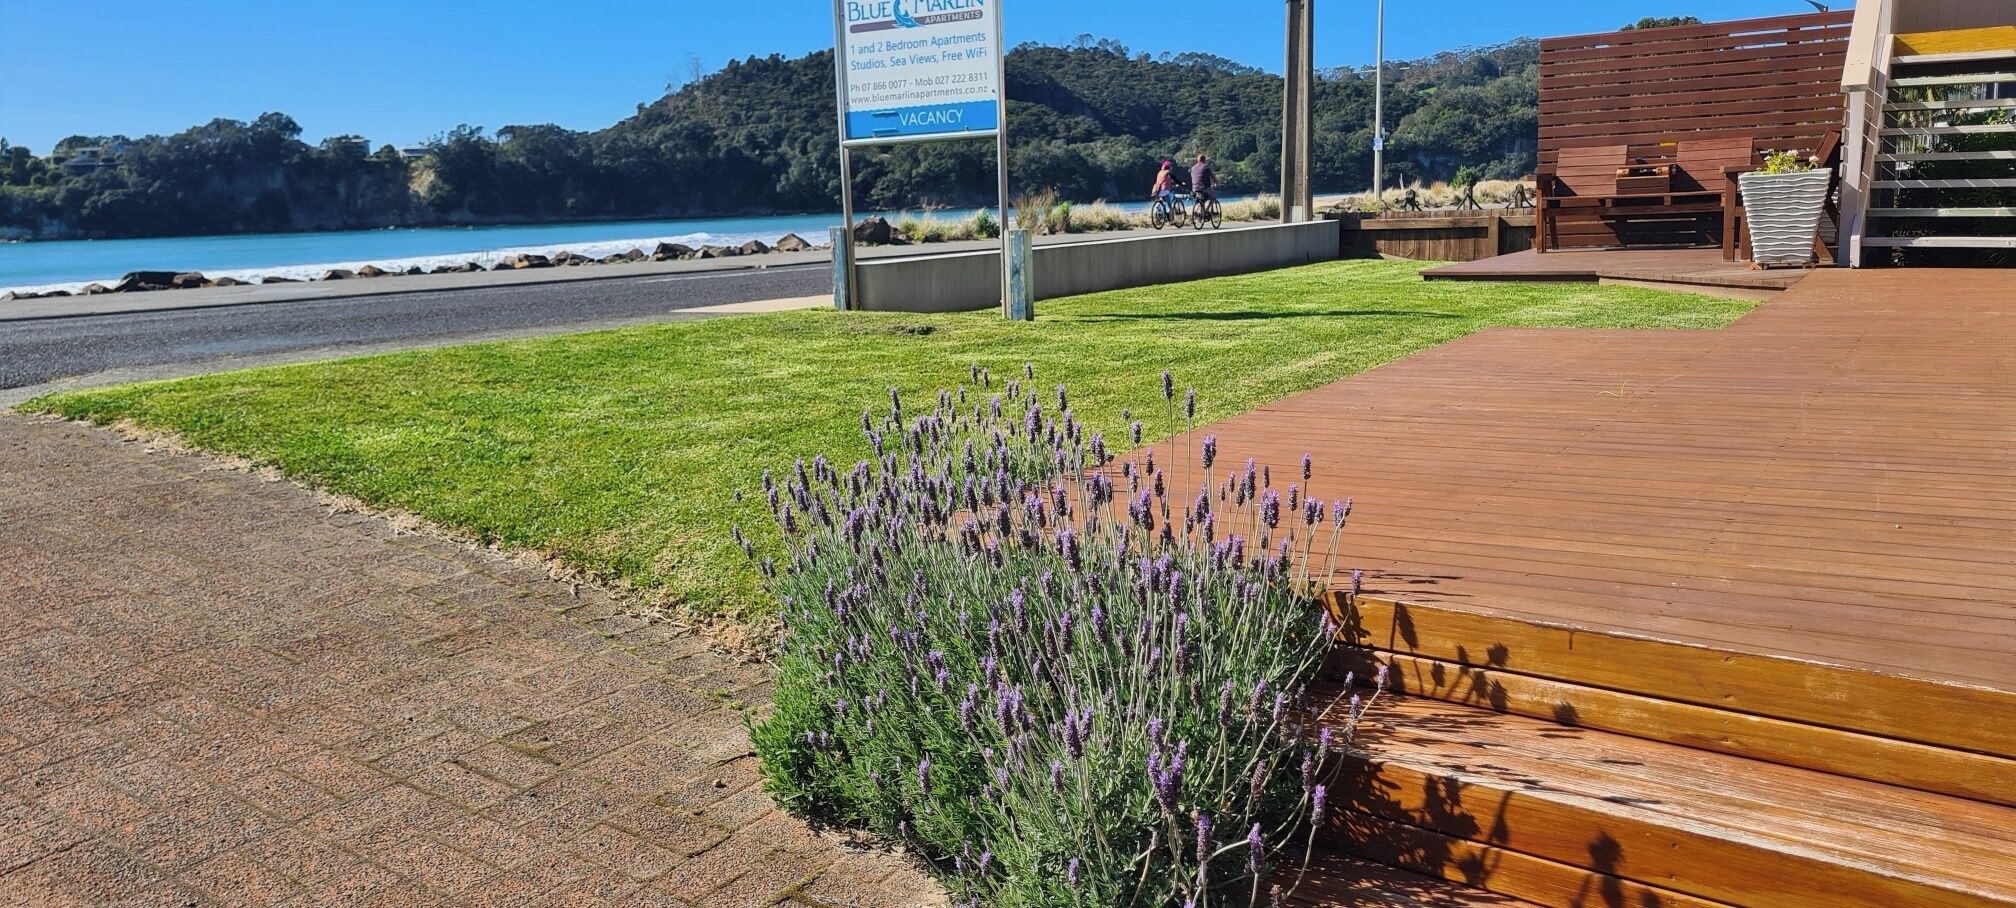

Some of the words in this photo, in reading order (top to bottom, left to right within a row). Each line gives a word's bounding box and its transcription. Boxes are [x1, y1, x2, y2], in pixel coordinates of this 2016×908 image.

[848, 1, 891, 22] BLUE
[925, 11, 981, 24] APARTMENTS
[851, 46, 855, 54] 1
[859, 43, 875, 54] and
[878, 43, 883, 52] 2
[886, 39, 927, 51] Bedroom
[931, 33, 986, 48] Apartments
[851, 60, 887, 71] Studios,
[890, 57, 906, 66] Sea
[910, 54, 939, 64] Views,
[943, 51, 963, 60] Free
[966, 47, 987, 58] WiFi
[851, 84, 860, 92] Ph
[862, 83, 871, 91] 07
[873, 81, 887, 90] 866
[889, 80, 907, 89] 0077
[915, 78, 933, 87] Mob
[935, 76, 949, 84] 027
[952, 74, 966, 83] 222
[969, 72, 987, 81] 8311
[851, 86, 988, 104] www.bluemarlinapartments.co.nz
[899, 109, 964, 126] VACANCY
